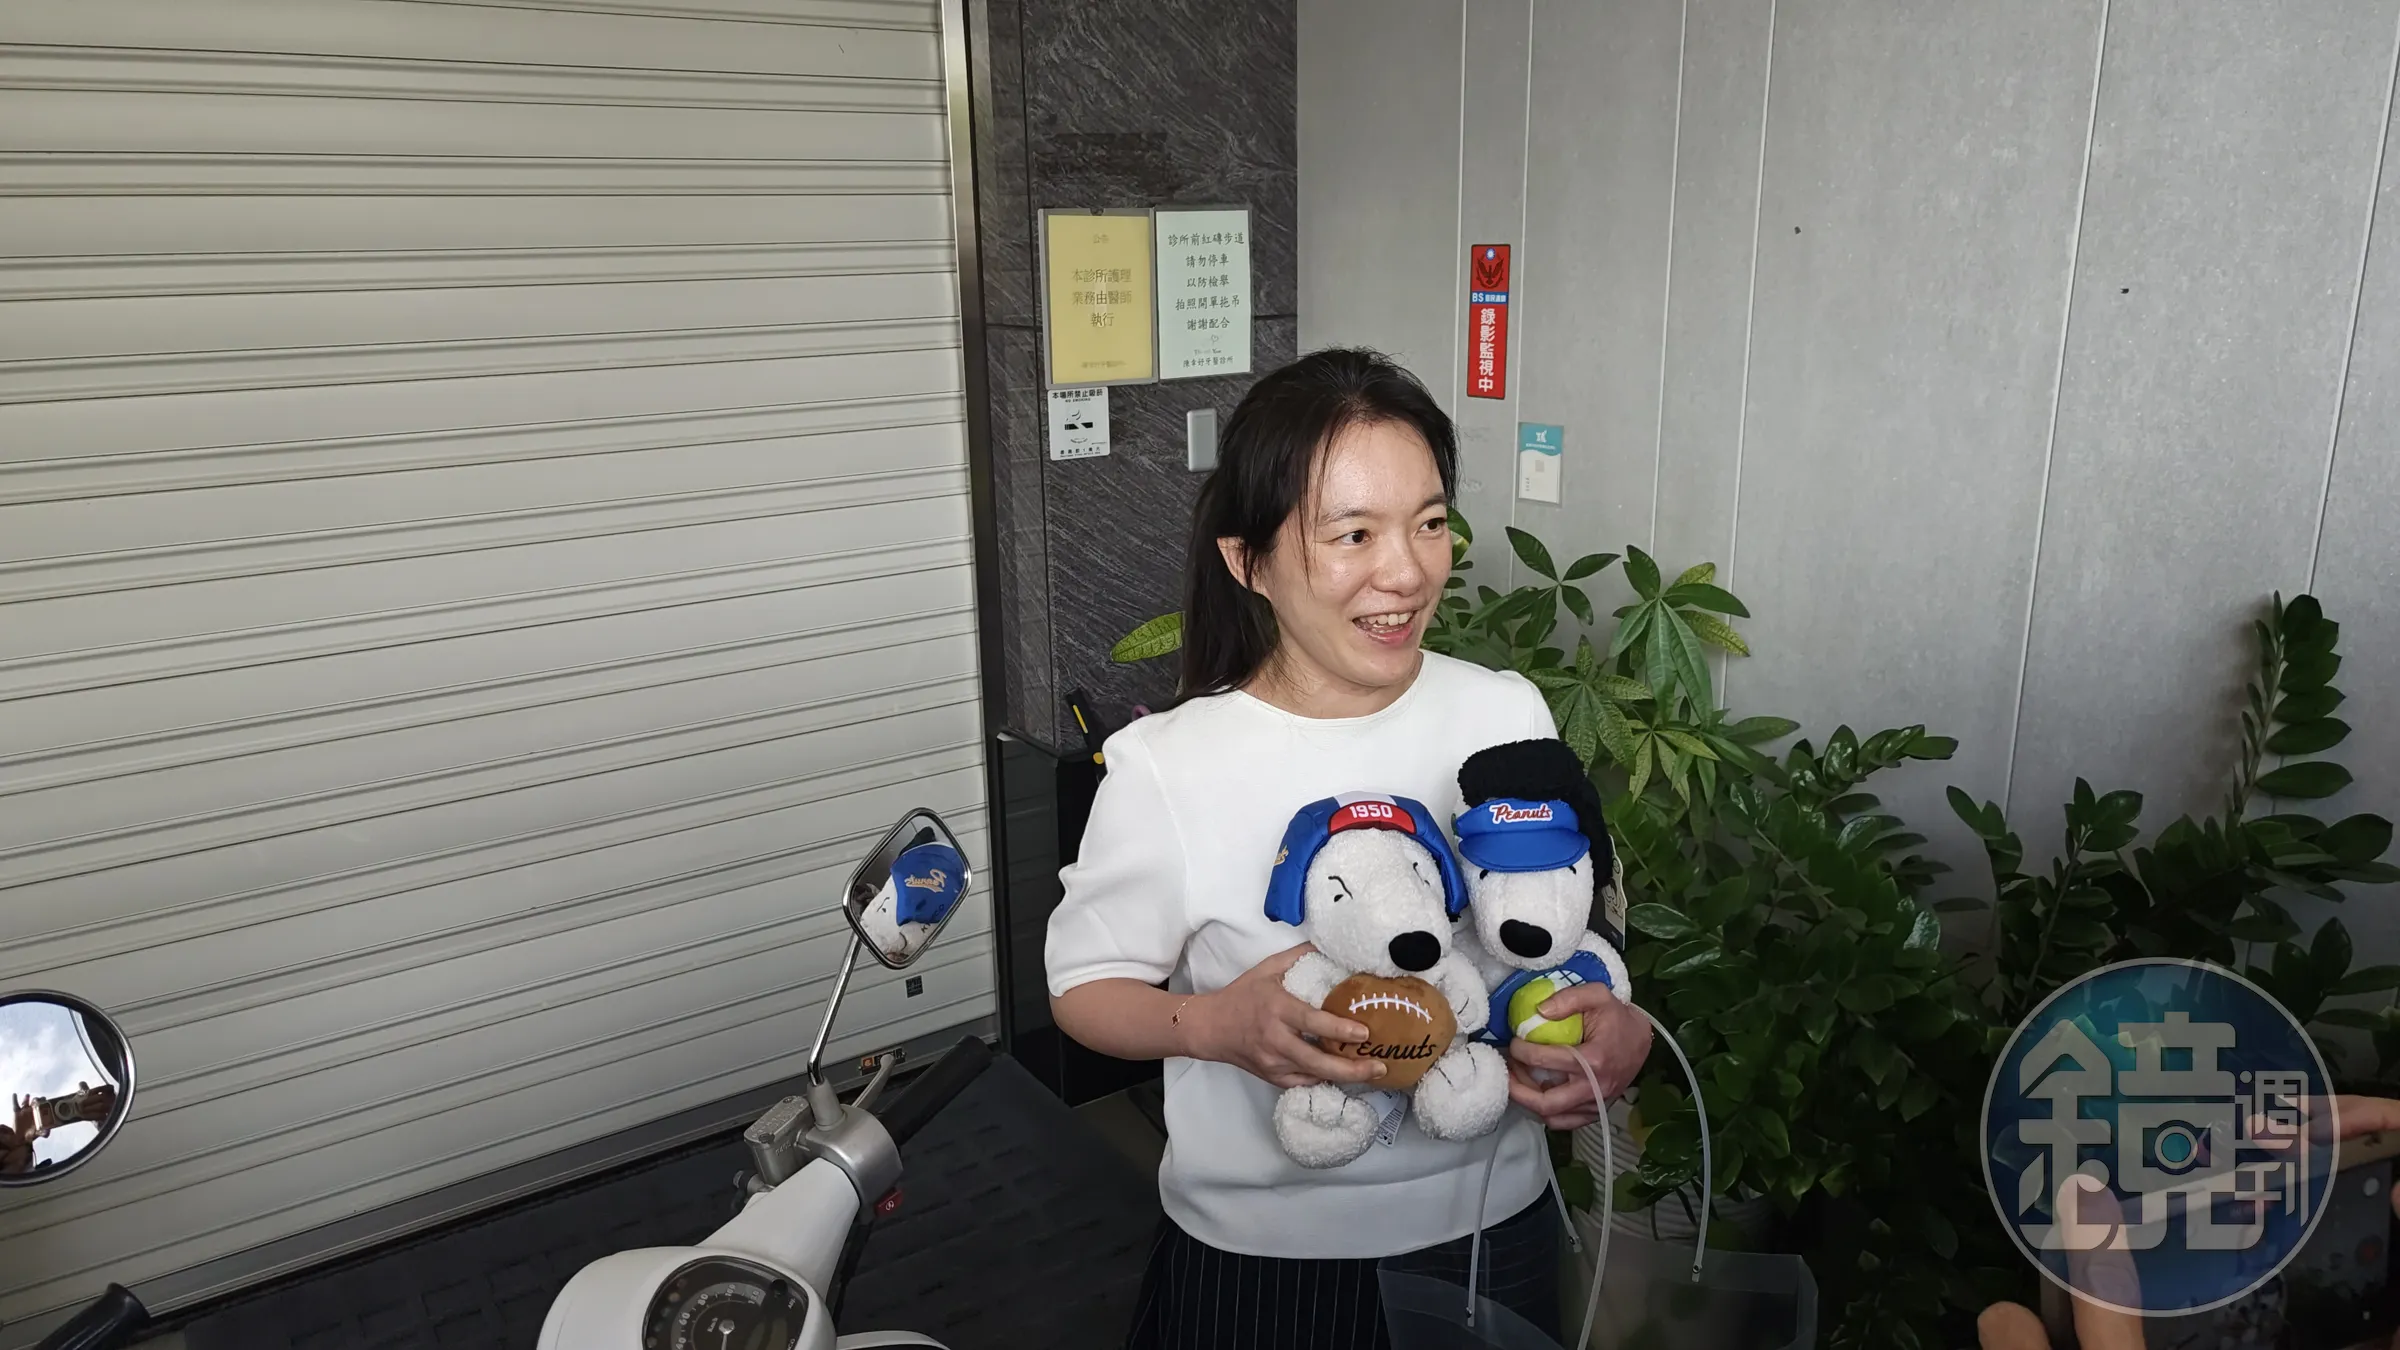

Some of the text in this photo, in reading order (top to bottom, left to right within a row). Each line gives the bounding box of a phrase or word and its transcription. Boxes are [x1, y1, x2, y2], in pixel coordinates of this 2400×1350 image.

[1168, 232, 1245, 247] 診所前紅磚步道
[1185, 253, 1230, 267] 請勿停車
[1072, 268, 1133, 283] 本診所護理
[1186, 275, 1230, 288] 以防檢舉
[1072, 290, 1133, 306] 業務由醫師
[1175, 295, 1240, 311] 拍照開單拖吊
[1472, 292, 1484, 302] BS
[1090, 312, 1116, 328] 執行
[1186, 316, 1230, 331] 謝謝配合
[1478, 308, 1496, 392] 錄影監視中
[1349, 803, 1393, 819] 1950
[1491, 804, 1552, 823] Peanuts
[1339, 1034, 1437, 1060] eanuts
[725, 1284, 736, 1297] 100
[697, 1293, 709, 1306] 80
[679, 1312, 691, 1326] 60
[675, 1337, 687, 1350] 40
